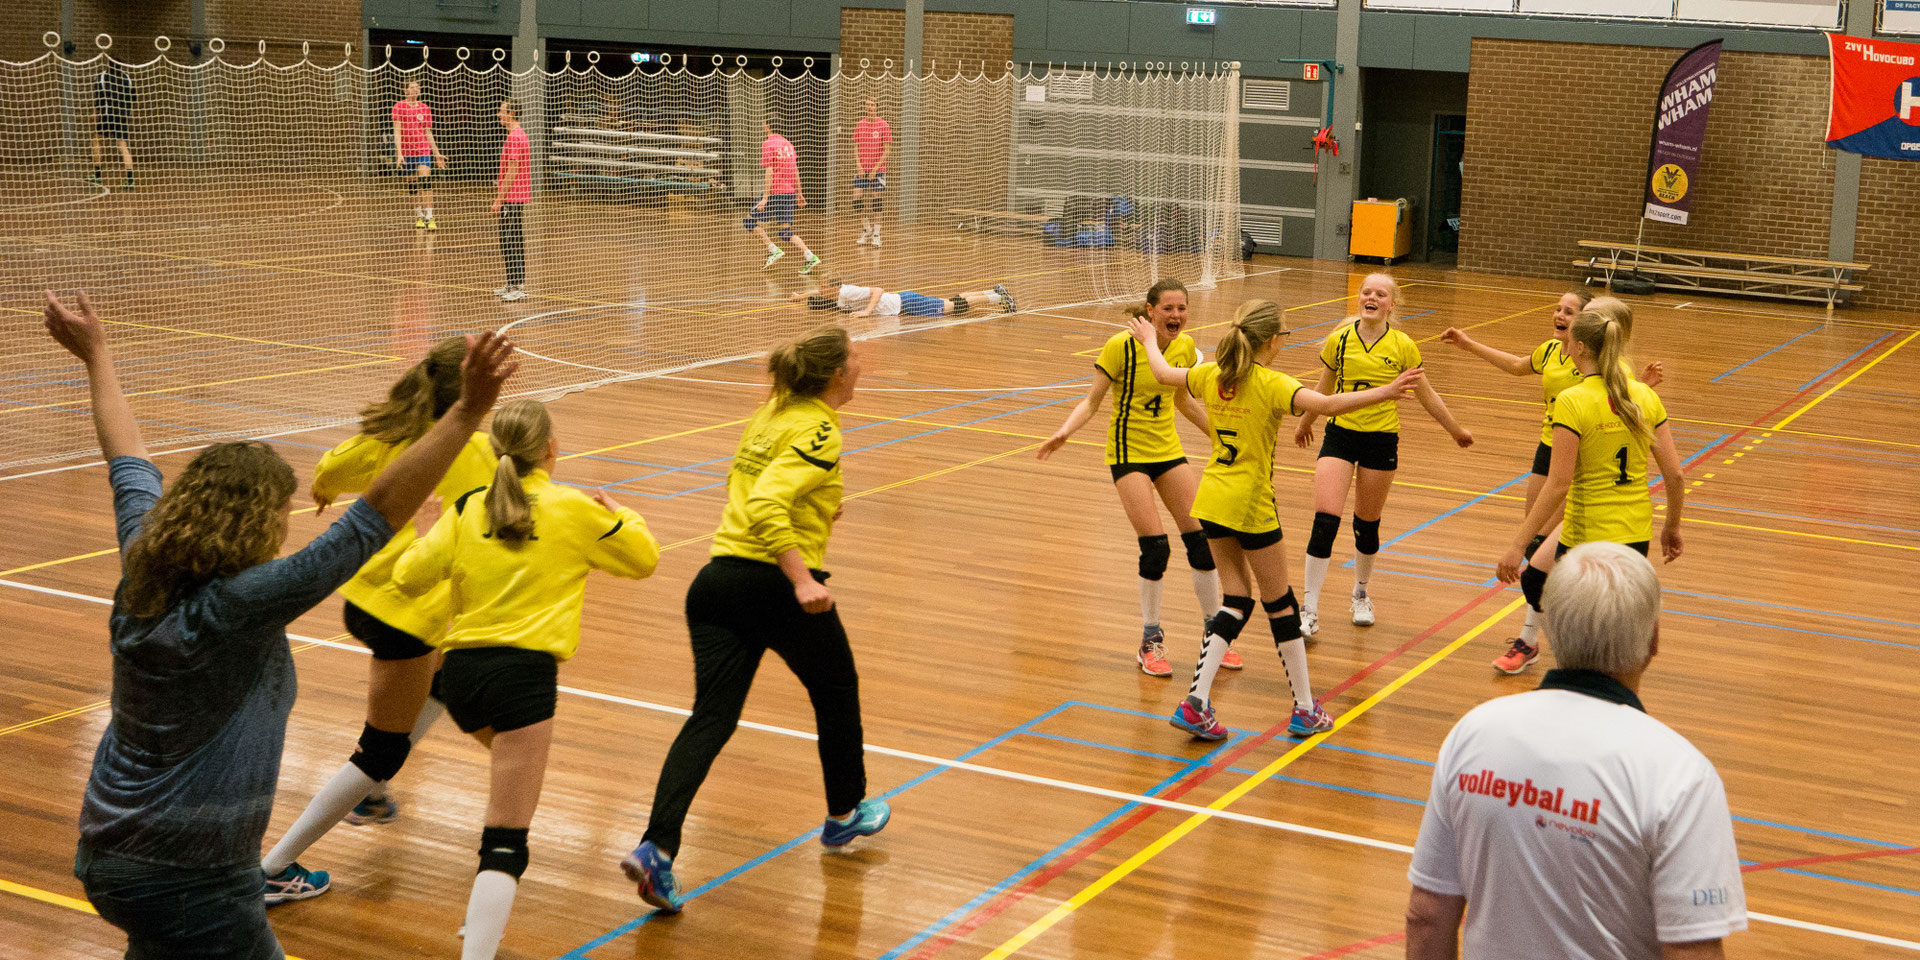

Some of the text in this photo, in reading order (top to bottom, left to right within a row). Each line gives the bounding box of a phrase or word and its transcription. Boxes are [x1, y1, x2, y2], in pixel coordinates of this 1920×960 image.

[1845, 41, 1862, 52] ZVV
[1658, 87, 1713, 131] WHAM
[1661, 68, 1717, 112] WHAM
[1144, 394, 1162, 418] 4
[1215, 428, 1239, 466] 5
[1614, 445, 1634, 485] 1
[1459, 769, 1601, 825] volleybal.nl
